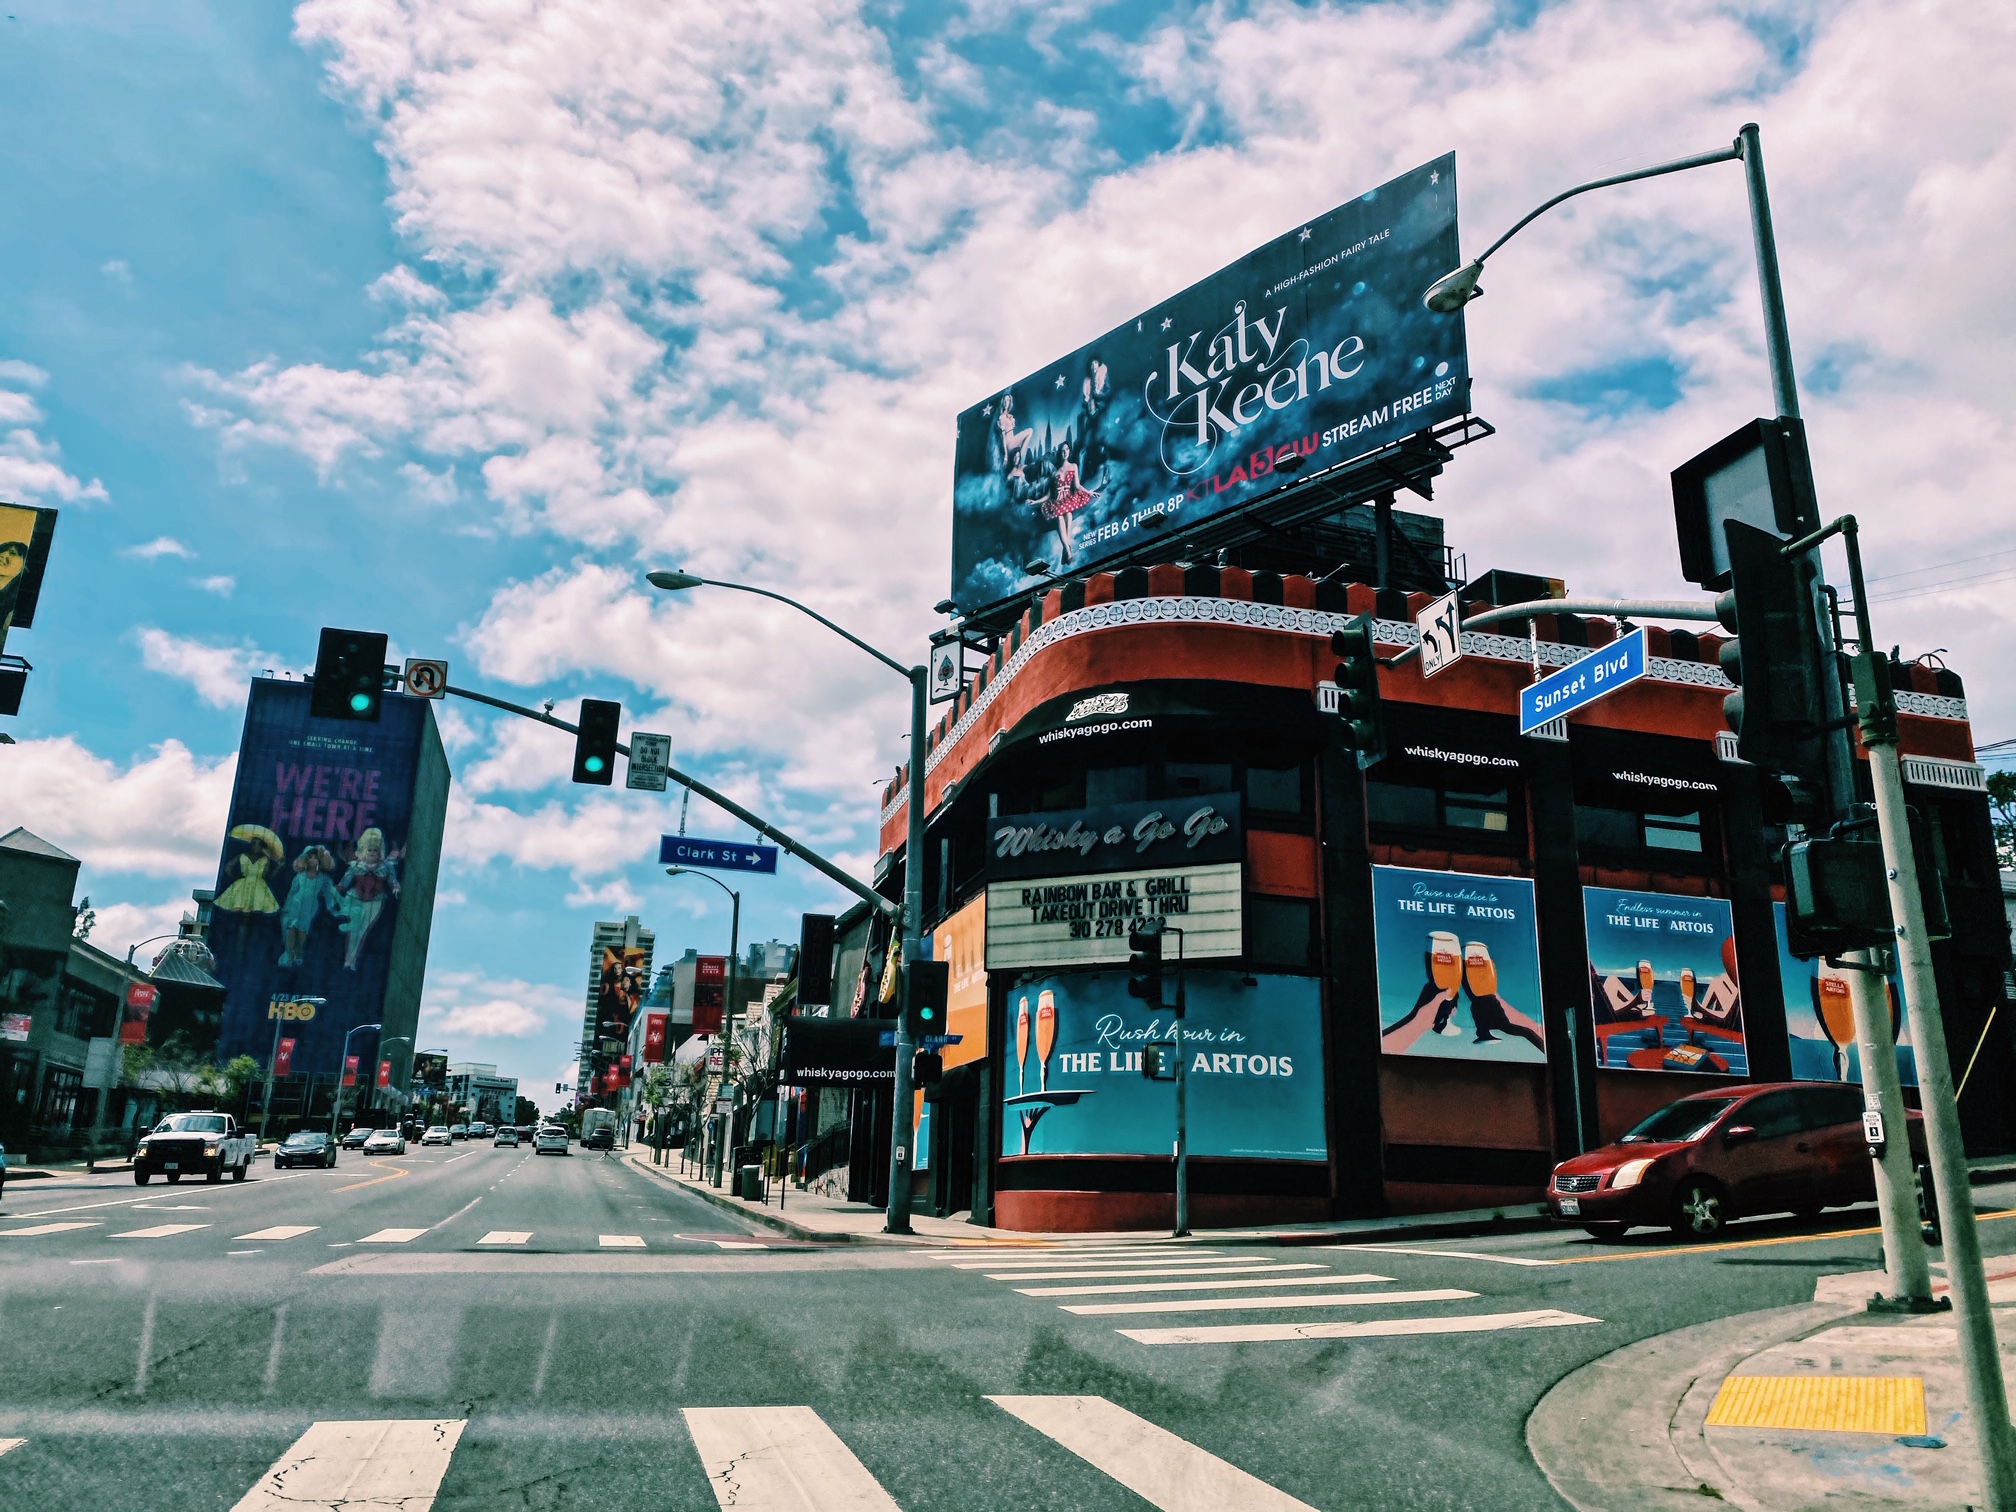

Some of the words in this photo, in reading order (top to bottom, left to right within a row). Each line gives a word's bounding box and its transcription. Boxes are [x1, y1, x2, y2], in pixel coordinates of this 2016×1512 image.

[1265, 289, 1272, 298] A
[1274, 254, 1339, 293] HIGH-FASHION
[1341, 240, 1367, 259] FAIRY
[1368, 228, 1390, 245] TALE
[1146, 299, 1288, 402] Katy
[1165, 336, 1364, 450] Keene
[1435, 376, 1456, 391] NEXT
[1435, 387, 1453, 400] DAY
[1322, 405, 1389, 447] STREAM
[1392, 387, 1433, 418] FREE
[1097, 522, 1119, 542] FEB
[1121, 516, 1130, 532] 6
[1167, 493, 1185, 513] 8P
[1078, 537, 1097, 550] SERIES
[1083, 530, 1097, 541] NEW
[1424, 655, 1441, 672] ONLY
[1535, 673, 1586, 713] Sunset
[1594, 650, 1628, 684] Blvd
[1039, 719, 1152, 744] whiskyagogo.com
[1404, 745, 1519, 767] whiskyagogo.com
[275, 760, 382, 802] WE'RE
[1612, 771, 1718, 791] whiskyagogo.com
[270, 795, 377, 841] HERE
[994, 820, 1098, 858] Whisky
[1103, 825, 1126, 844] a
[1132, 811, 1176, 853] Go
[1184, 806, 1229, 848] Go
[676, 845, 714, 860] Clark
[722, 850, 737, 862] St
[1022, 884, 1088, 905] RAINBOW
[1091, 880, 1122, 900] BAR
[1126, 880, 1137, 897] &
[1145, 876, 1191, 896] GRILL
[1412, 881, 1444, 901] Raise
[1445, 891, 1454, 899] a
[1453, 889, 1487, 902] chalice
[1487, 893, 1499, 902] to
[1031, 902, 1095, 923] TAKEOUT
[1099, 898, 1143, 919] DRIVE
[1397, 899, 1425, 912] THE
[1428, 902, 1456, 915] LIFE
[1467, 905, 1516, 920] ARTOIS
[1616, 898, 1654, 916] Endless
[1655, 906, 1691, 917] summer
[1069, 920, 1091, 938] 310
[1095, 919, 1124, 937] 278
[1607, 914, 1632, 927] THE
[1634, 917, 1660, 929] LIFE
[1670, 920, 1714, 933] ARTOIS
[1825, 981, 1845, 989] STELLA
[268, 1001, 316, 1021] HBO
[925, 1035, 948, 1043] CLARK
[1095, 1014, 1160, 1049] Rush
[1164, 1019, 1217, 1042] hour
[1219, 1027, 1246, 1042] in
[797, 1067, 896, 1080] whiskyagogo.com
[1059, 1053, 1102, 1074] THE
[1191, 1053, 1294, 1078] ARTOIS
